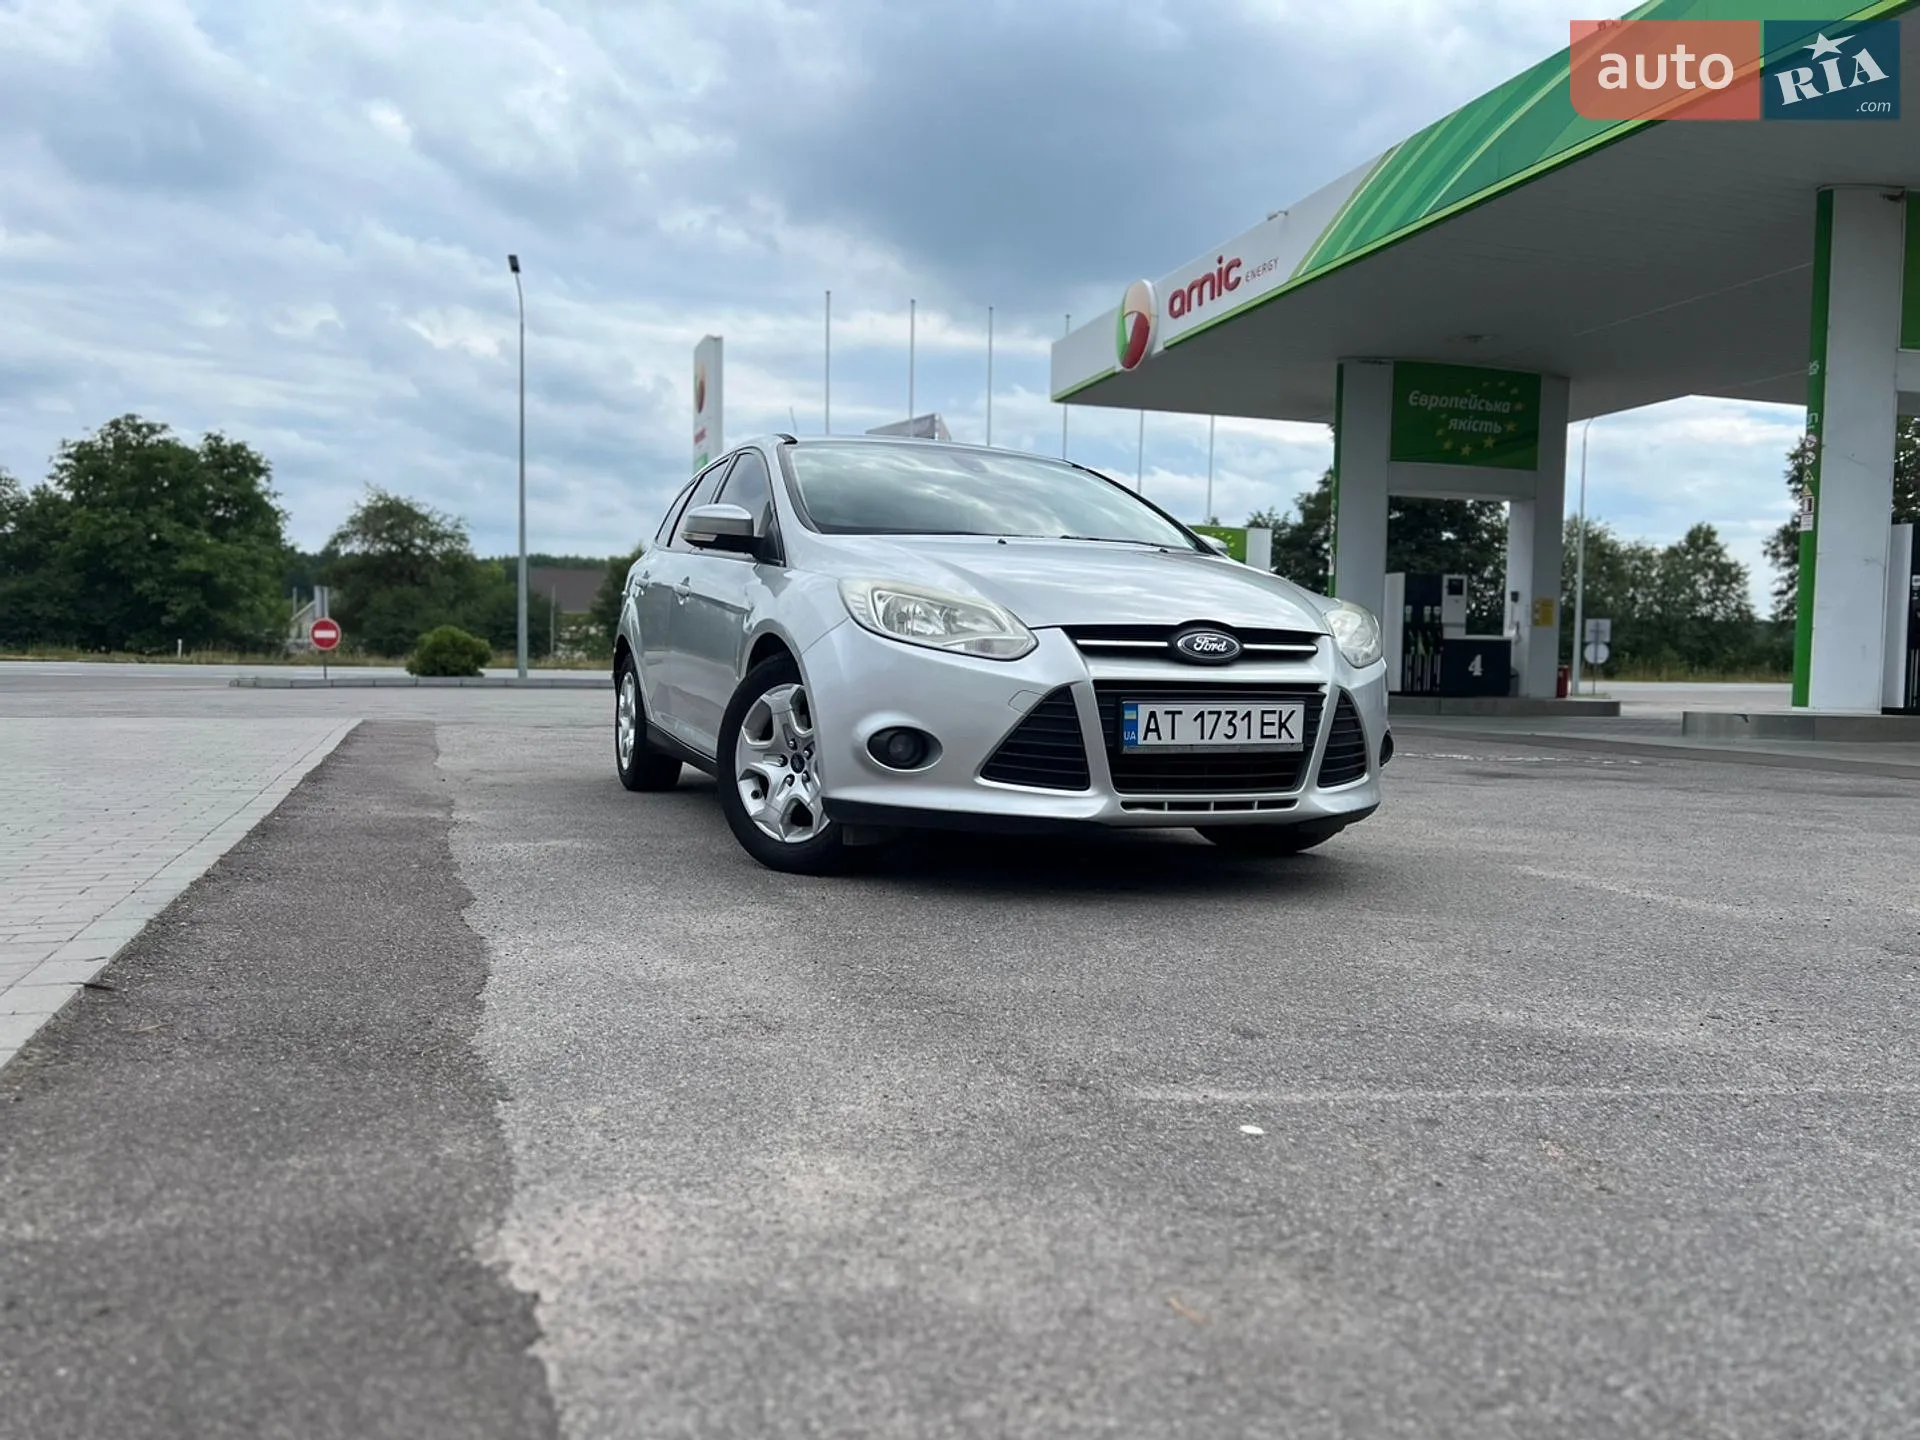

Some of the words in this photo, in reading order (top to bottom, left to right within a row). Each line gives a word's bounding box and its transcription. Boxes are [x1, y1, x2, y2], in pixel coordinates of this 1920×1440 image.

[1168, 254, 1242, 319] amic
[1245, 257, 1280, 283] ENERGY
[1408, 390, 1512, 413] Європейська
[1448, 416, 1502, 434] якість
[1192, 636, 1228, 653] Ford
[1468, 654, 1484, 676] 4
[1123, 731, 1137, 741] UA
[1142, 710, 1183, 741] AT
